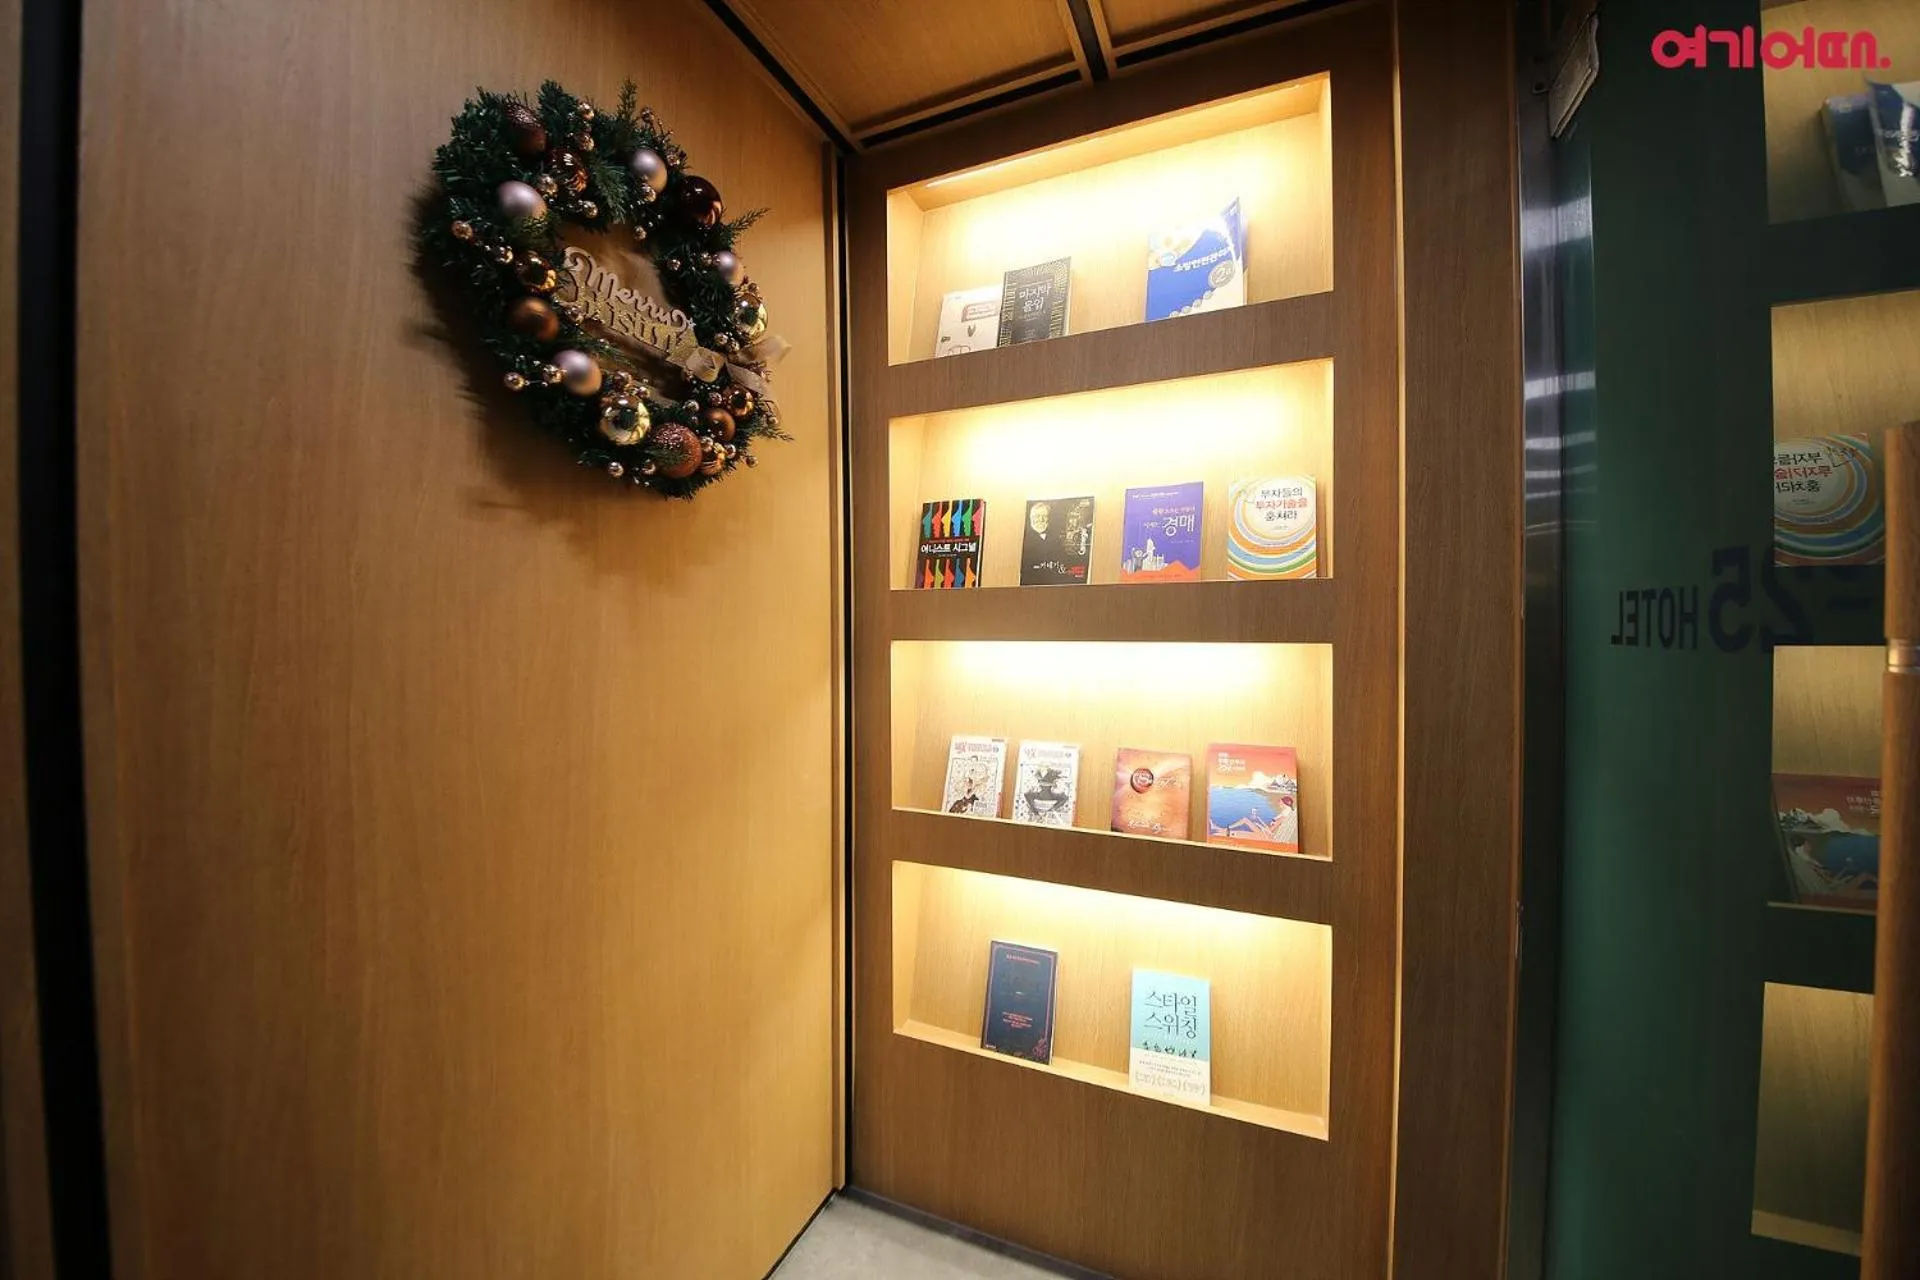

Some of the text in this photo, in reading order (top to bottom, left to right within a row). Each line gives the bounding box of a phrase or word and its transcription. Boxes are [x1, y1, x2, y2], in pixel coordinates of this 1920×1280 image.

[563, 246, 689, 334] Merry
[1260, 487, 1303, 498] 부자들의
[1256, 497, 1308, 510] 투자기술을
[1161, 514, 1195, 536] 경매
[920, 542, 977, 554] 어니스트 시그널
[1144, 991, 1197, 1016] 스타일
